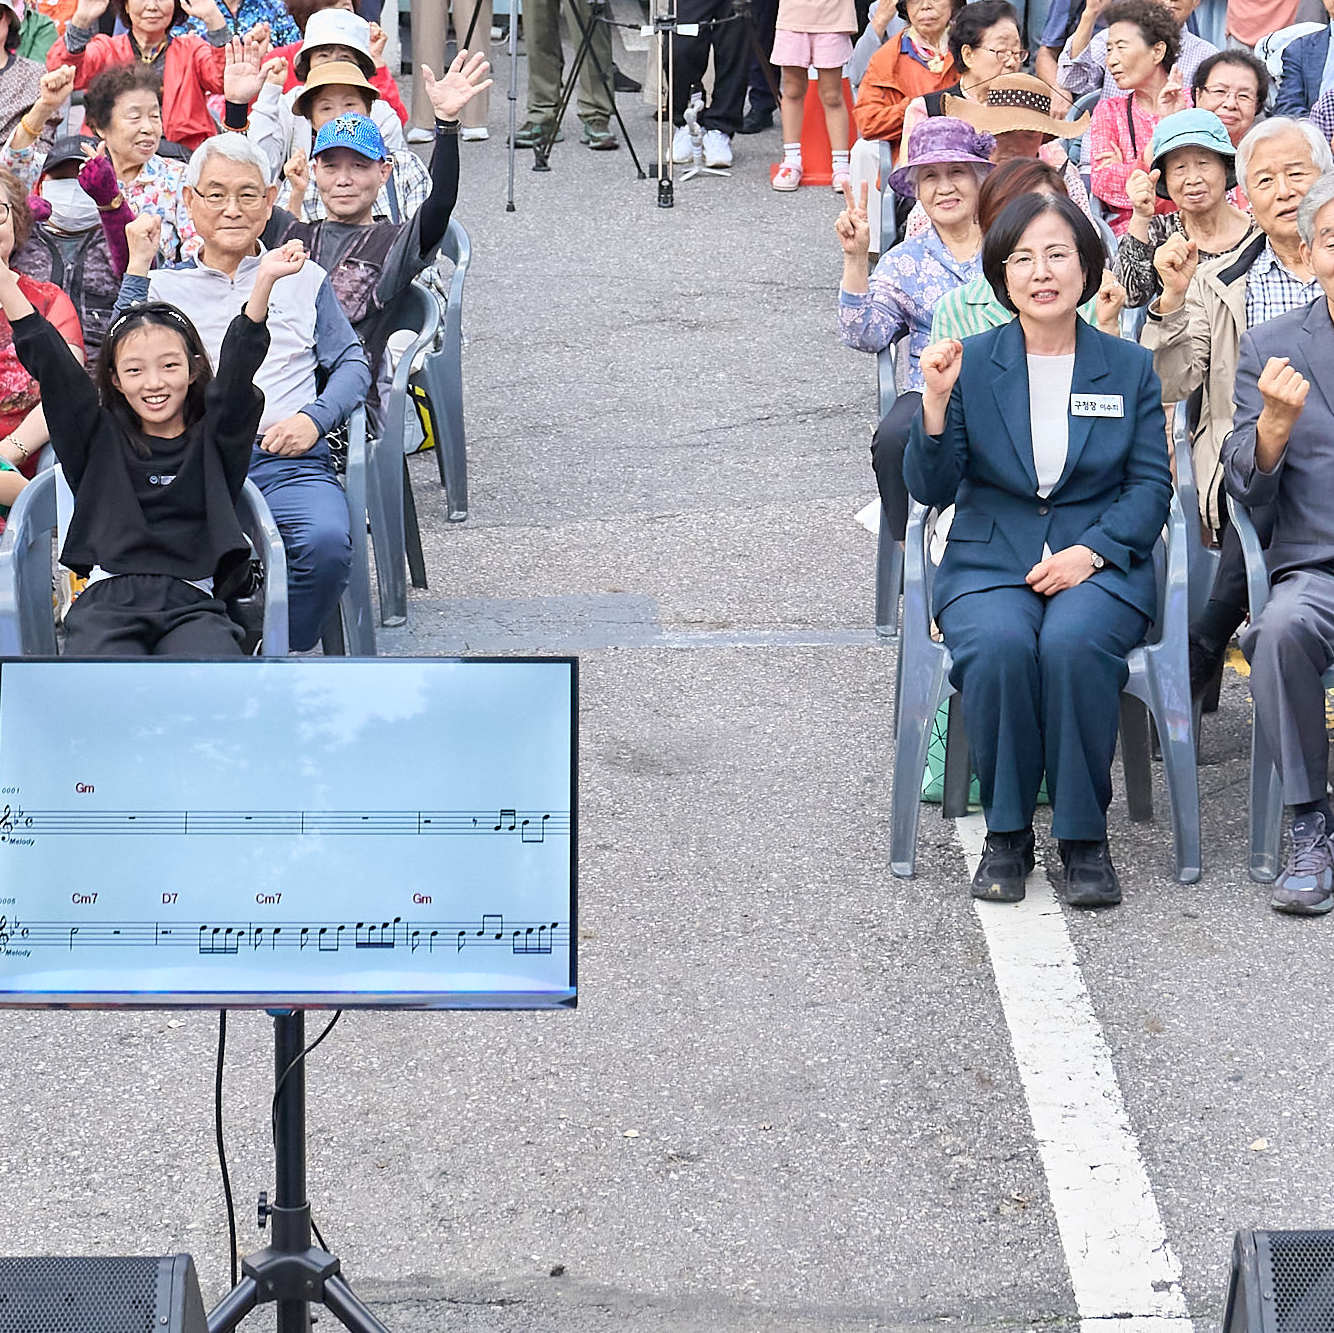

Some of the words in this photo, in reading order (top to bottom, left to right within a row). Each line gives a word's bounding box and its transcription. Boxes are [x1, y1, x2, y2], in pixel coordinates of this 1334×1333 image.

[75, 782, 95, 794] Gm
[9, 838, 36, 846] Melody
[72, 893, 98, 905] Cm7
[162, 892, 178, 905] D7
[255, 893, 282, 905] Cm7
[412, 893, 432, 905] Gm
[5, 949, 32, 957] Melody
